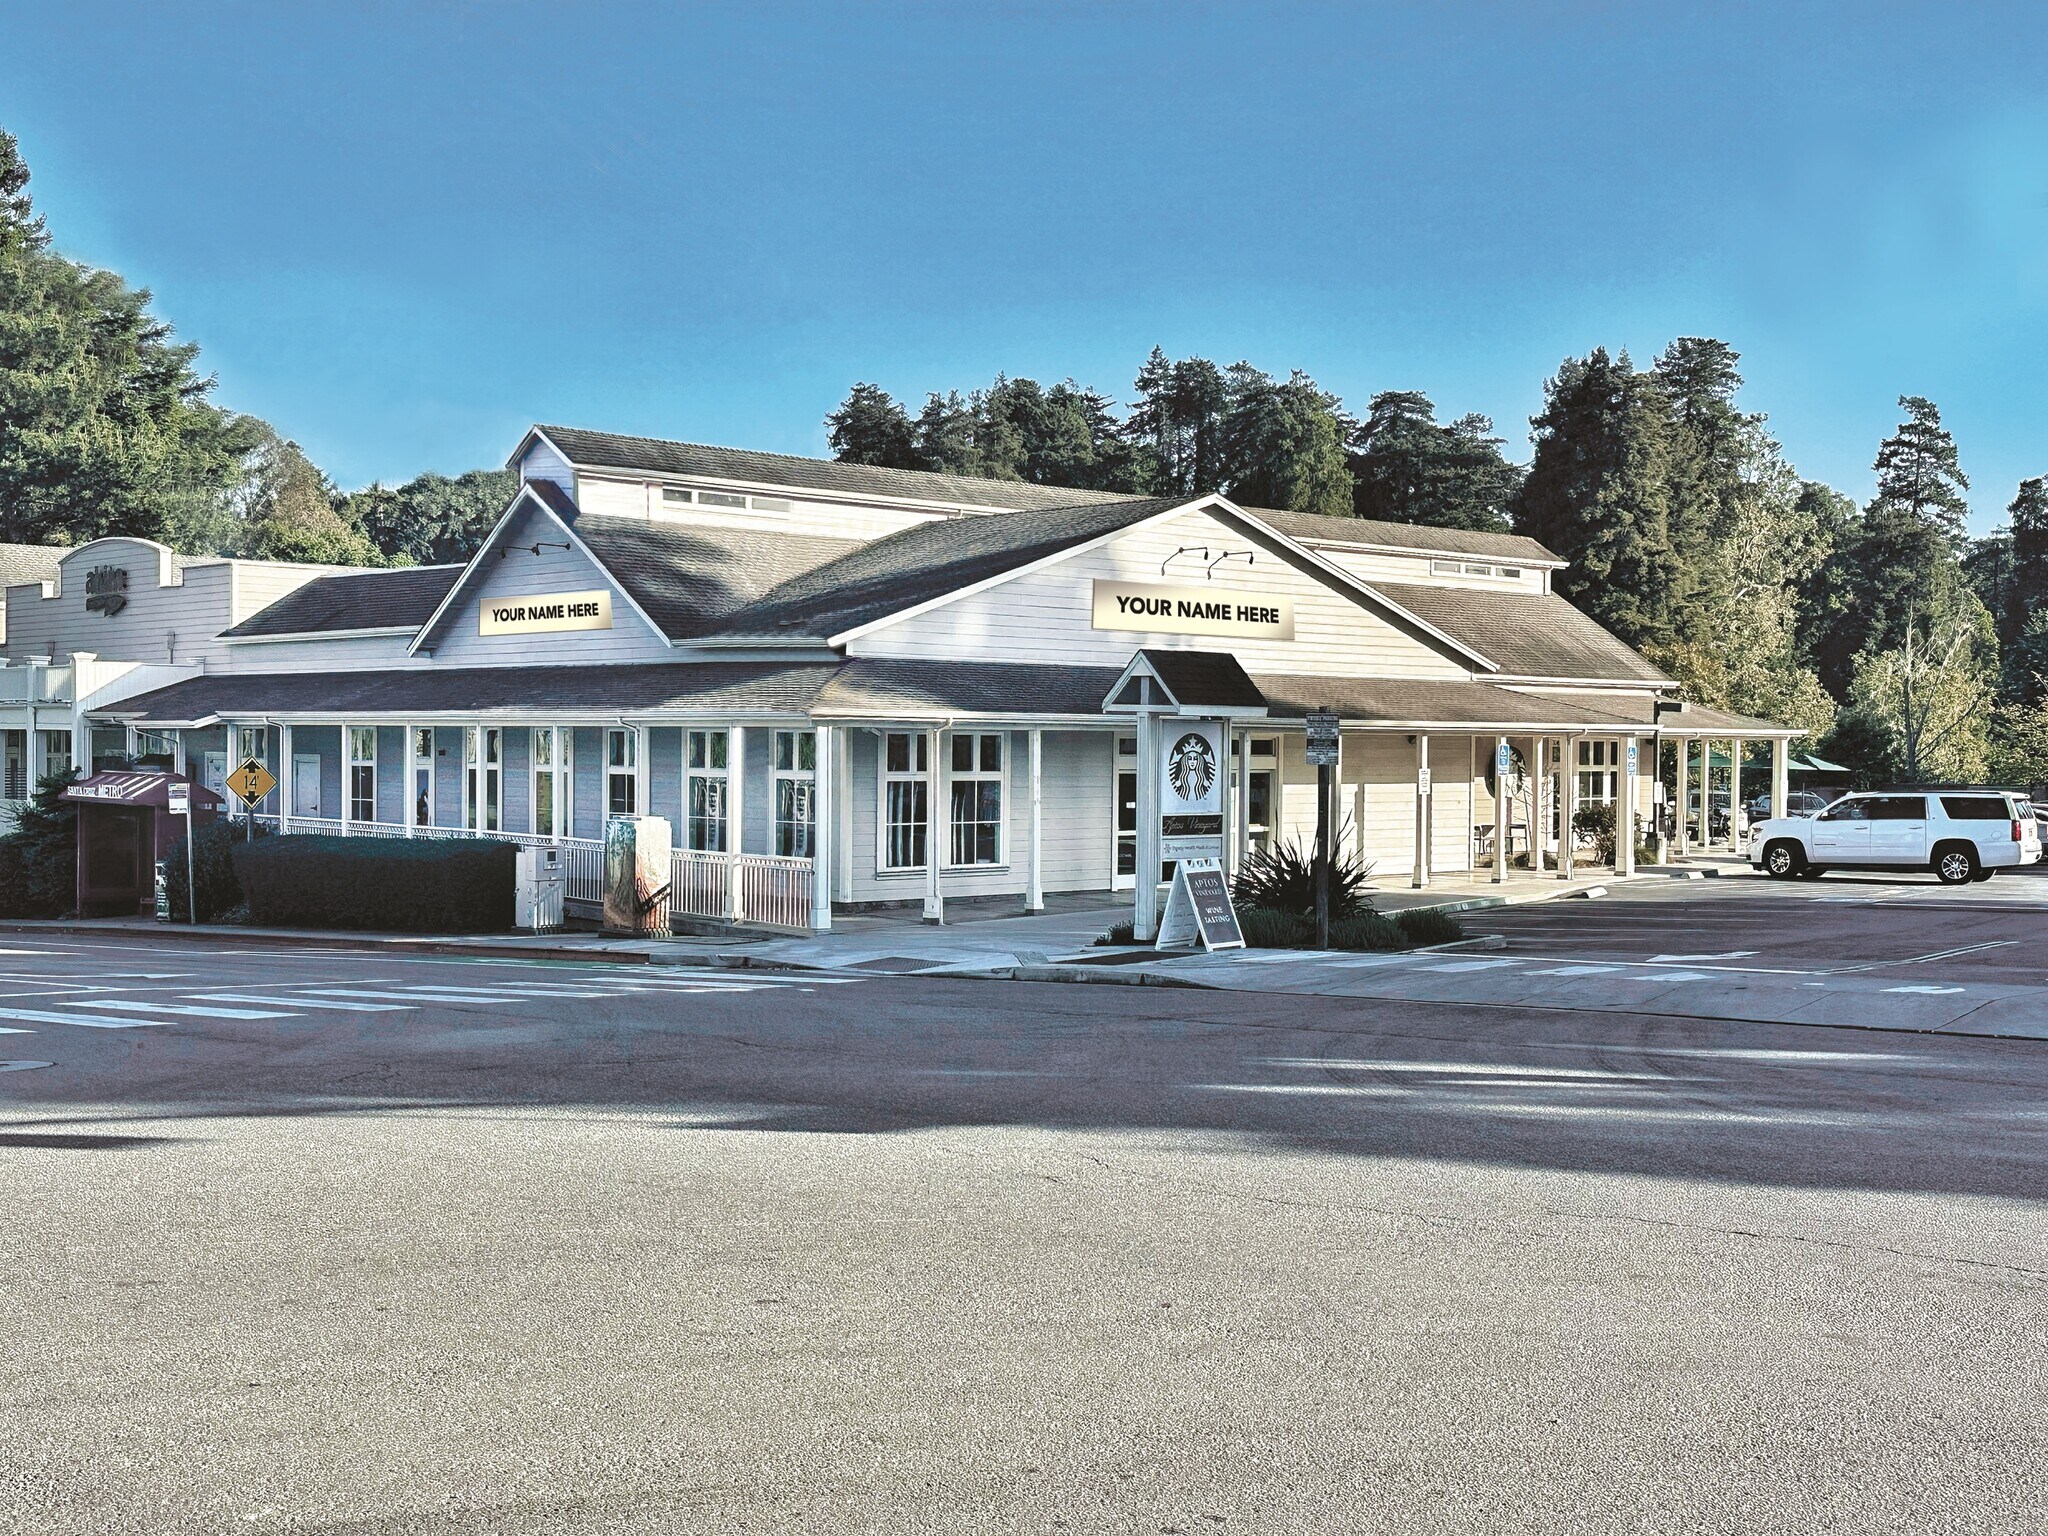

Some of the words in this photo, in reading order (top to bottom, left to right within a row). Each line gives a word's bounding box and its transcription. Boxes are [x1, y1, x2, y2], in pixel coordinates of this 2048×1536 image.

[492, 607, 526, 622] YOUR
[528, 604, 565, 620] NAME
[567, 602, 600, 618] HERE
[1115, 595, 1172, 617] YOUR
[1177, 600, 1232, 621] NAME
[1236, 605, 1280, 624] HERE
[67, 785, 83, 797] SANTA
[98, 783, 124, 798] METRO
[1194, 878, 1219, 889] APTOS
[1205, 906, 1224, 915] WINE
[1204, 914, 1231, 924] TASTING
